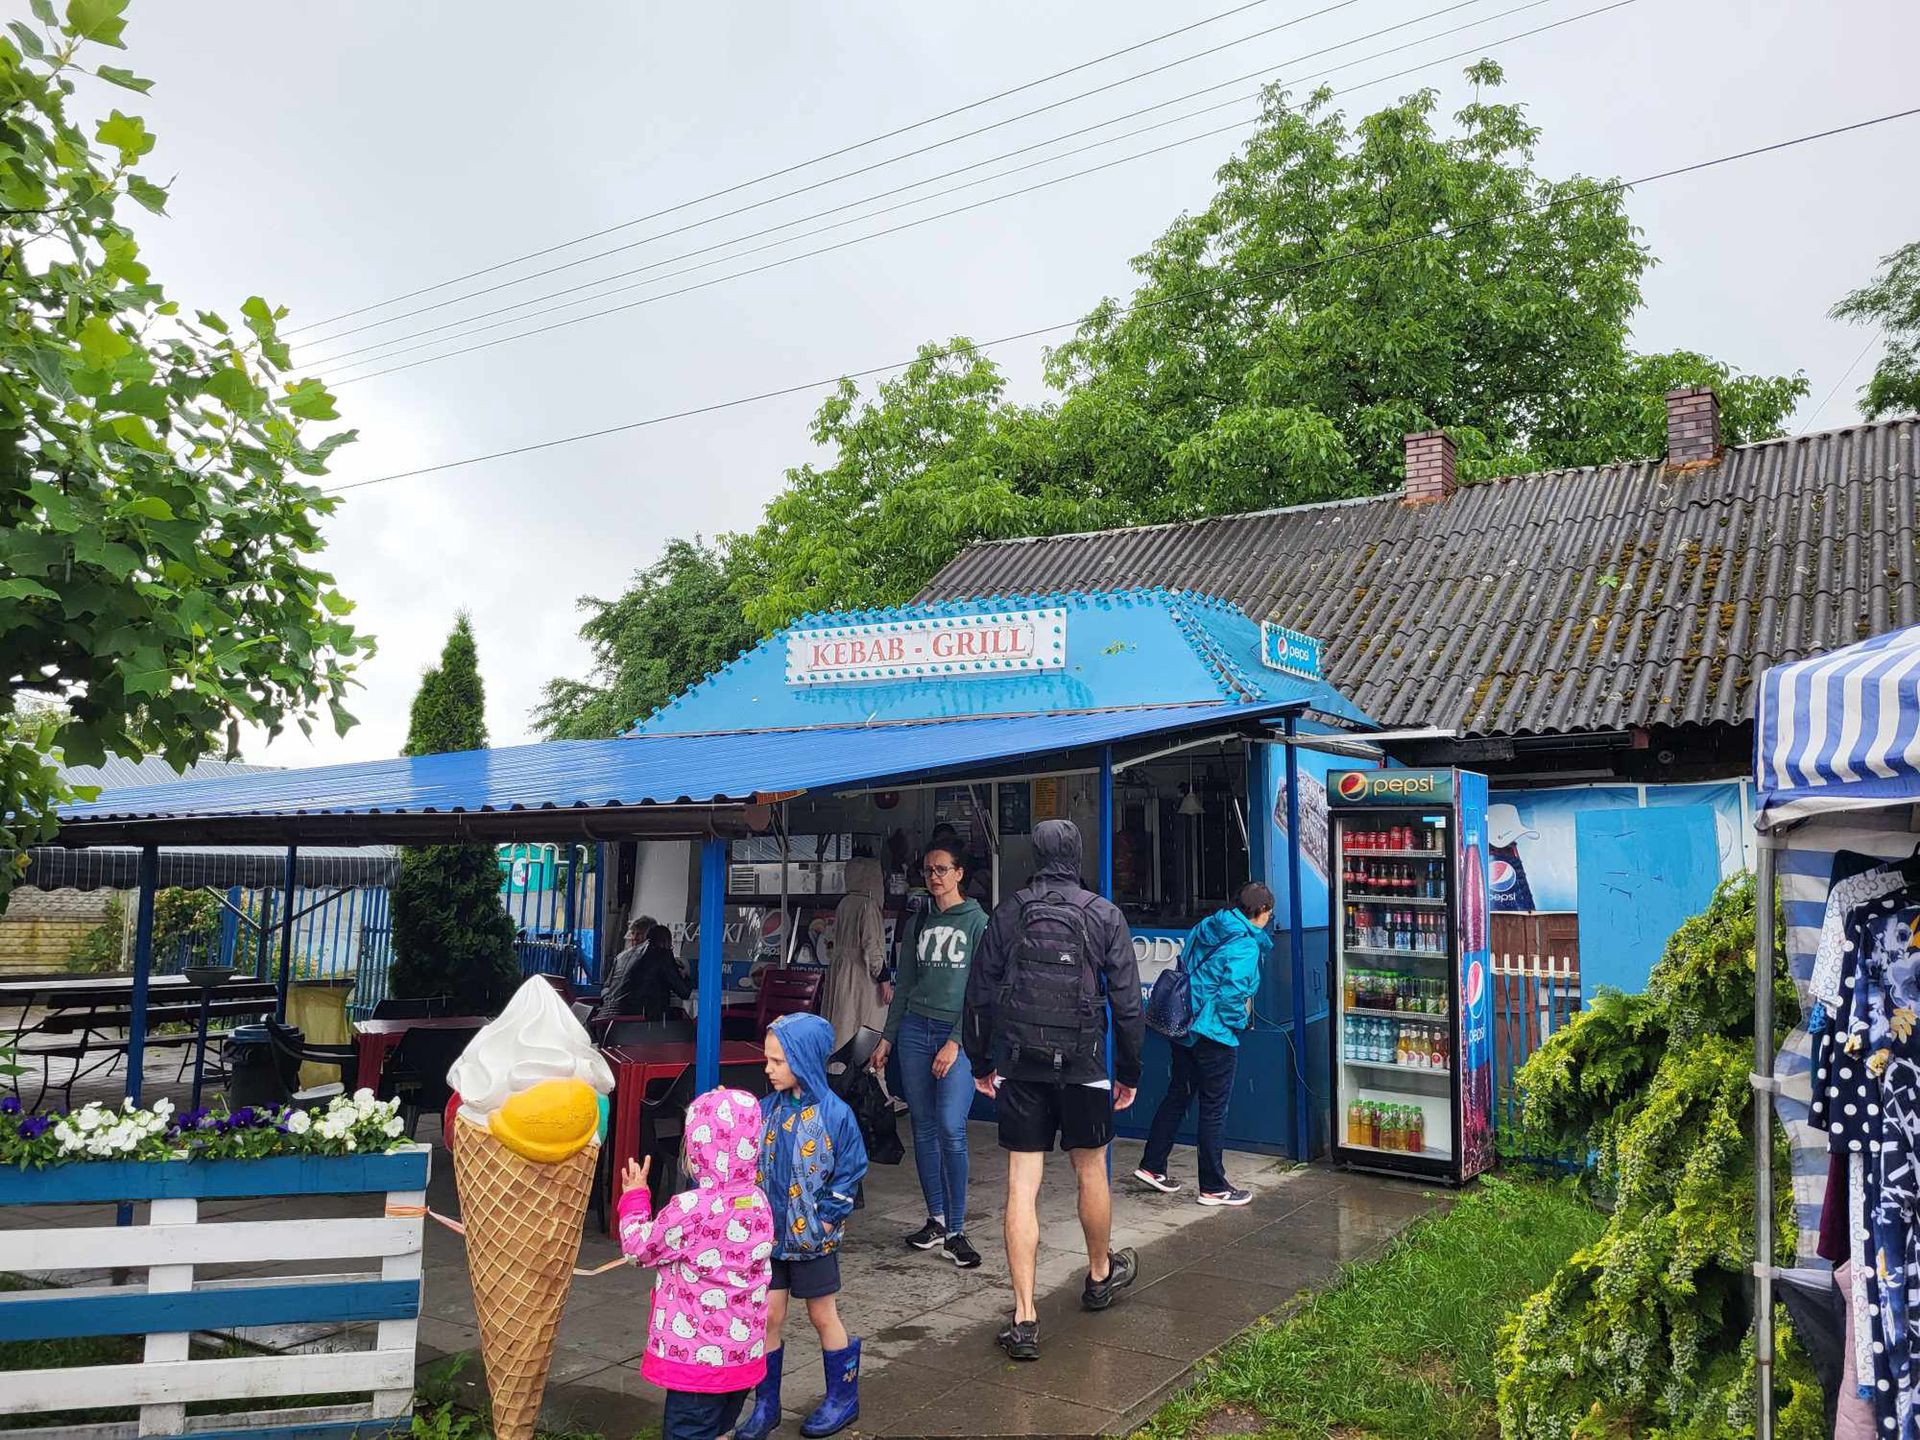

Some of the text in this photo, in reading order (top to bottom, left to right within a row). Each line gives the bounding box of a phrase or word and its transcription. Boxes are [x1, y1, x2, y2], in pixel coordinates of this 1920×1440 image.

[811, 636, 905, 667] KEBAB
[932, 628, 1026, 659] GRILL
[1374, 774, 1434, 796] pepsi
[917, 926, 967, 962] NYC
